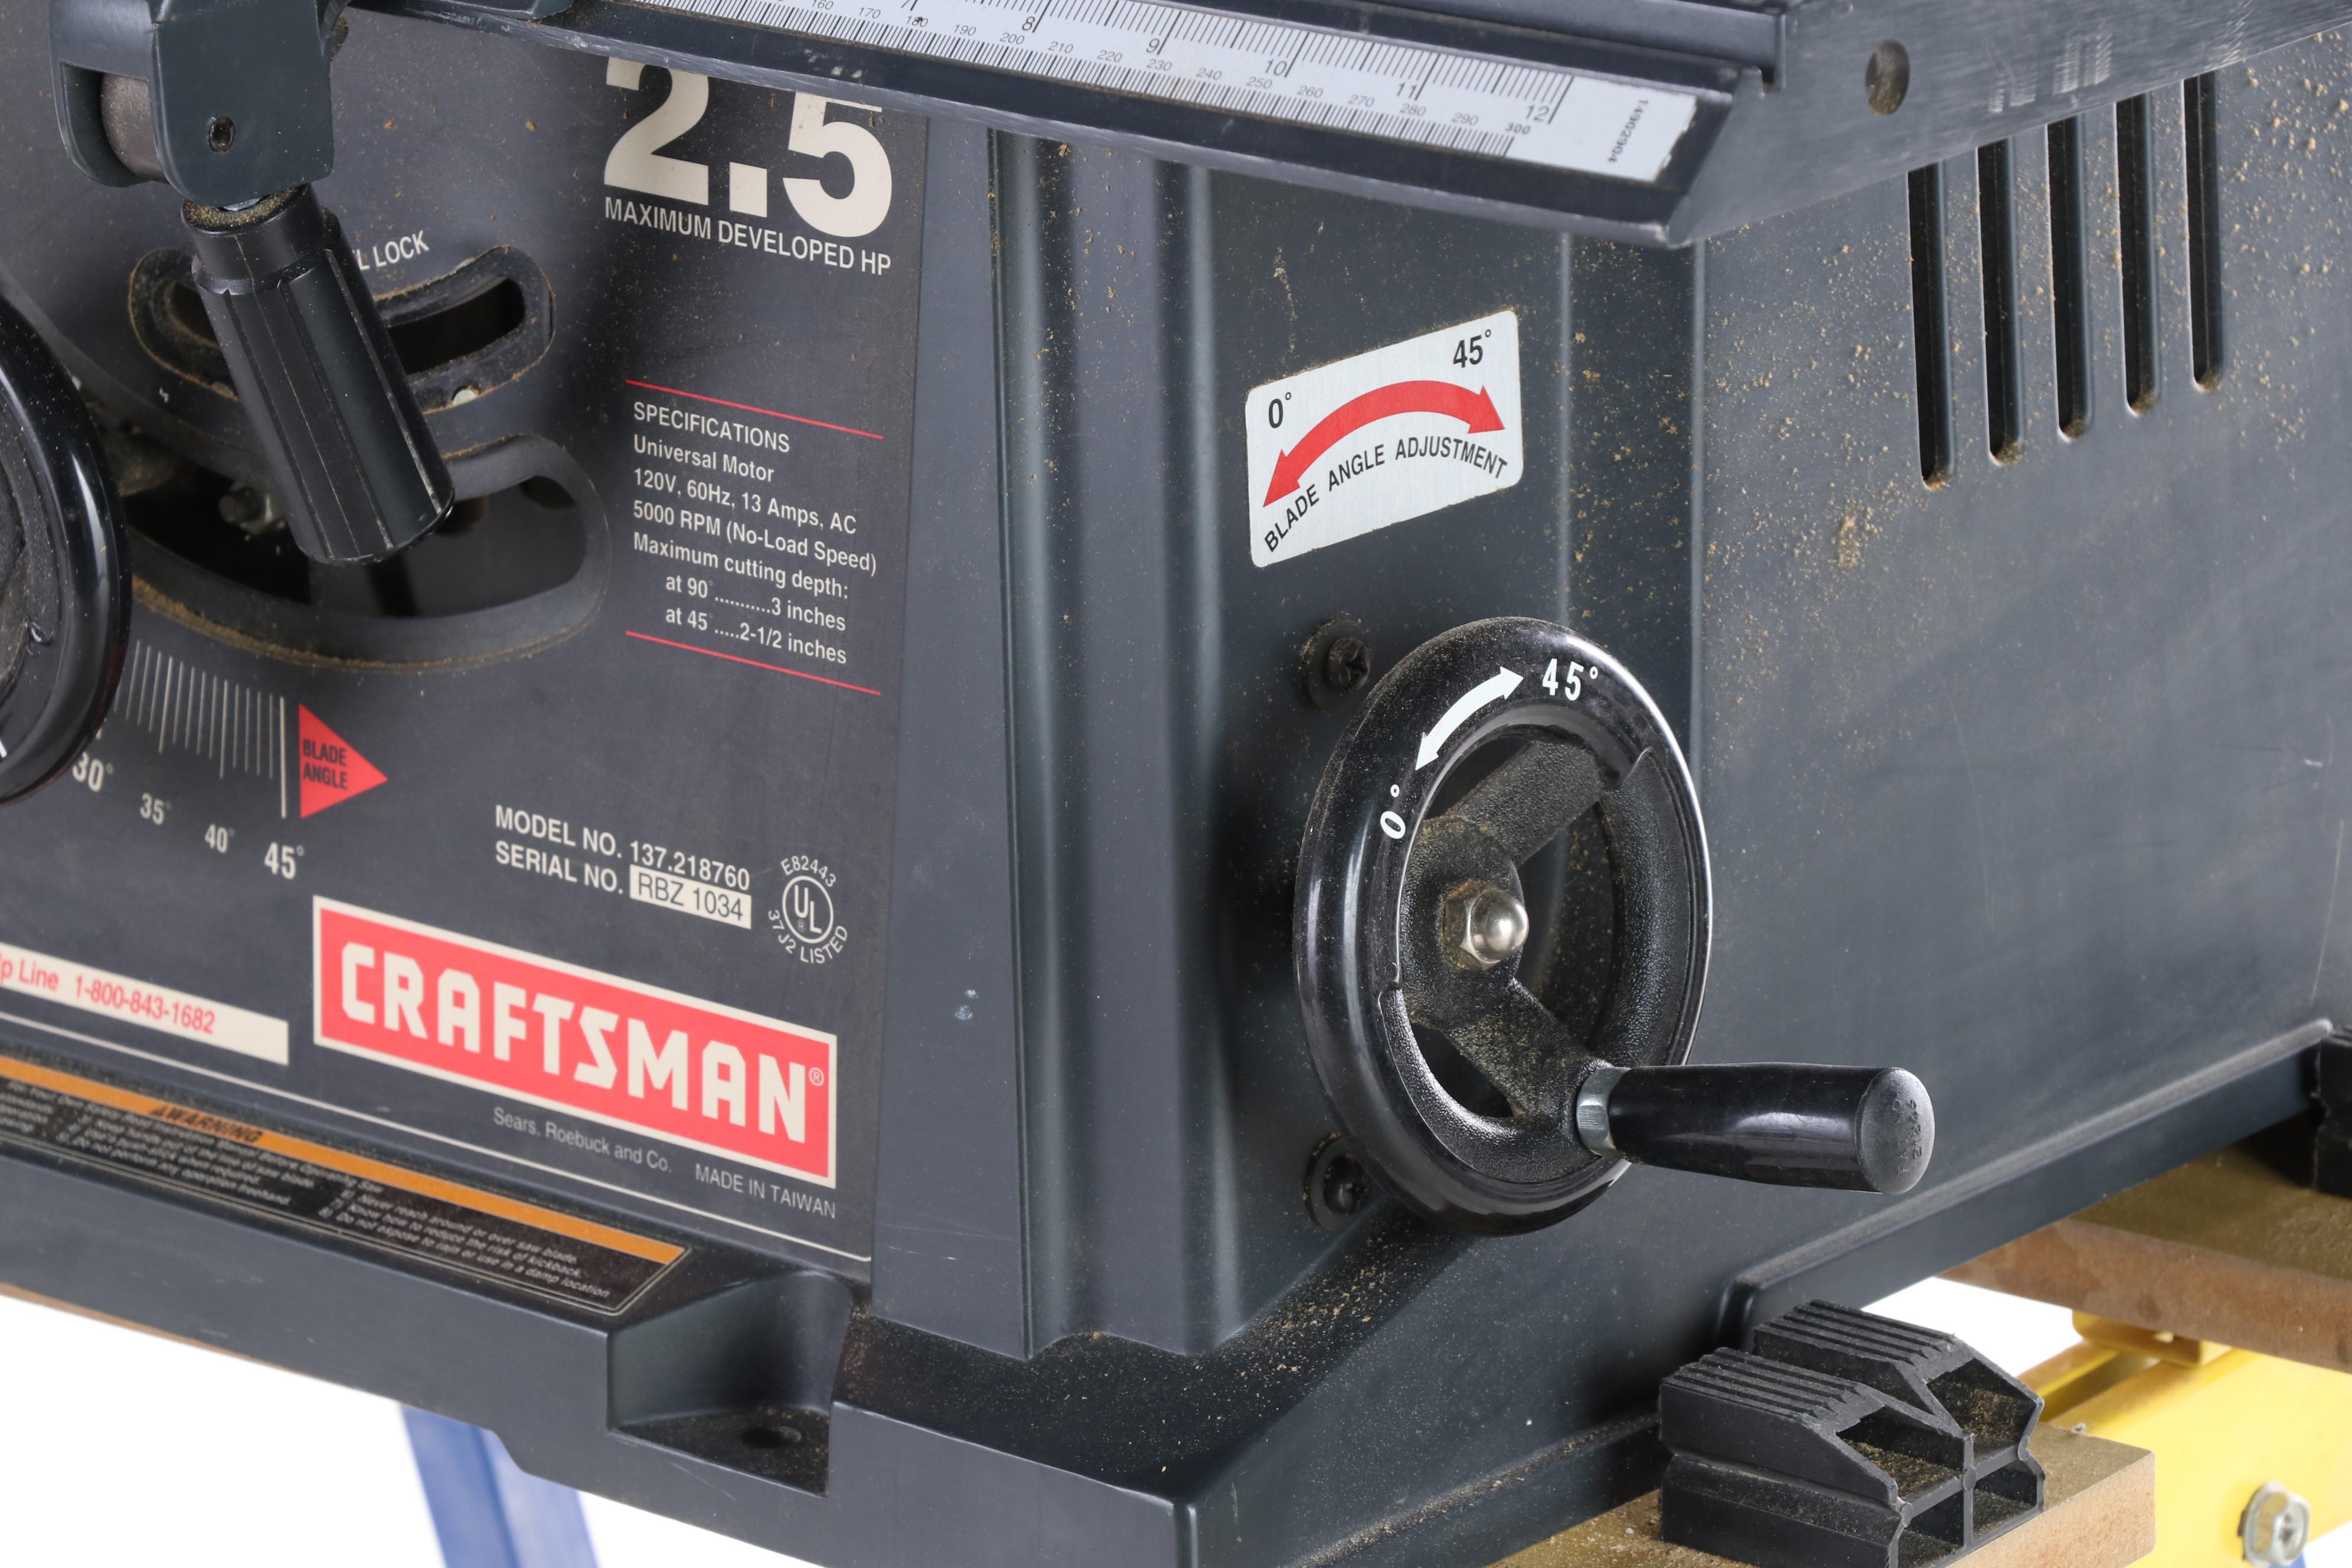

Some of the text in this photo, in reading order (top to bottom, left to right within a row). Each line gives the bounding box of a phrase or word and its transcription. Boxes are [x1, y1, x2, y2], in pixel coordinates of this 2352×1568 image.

[859, 7, 881, 19] 170
[954, 24, 976, 36] 190
[999, 32, 1025, 44] 200
[1048, 41, 1074, 53] 210
[1097, 50, 1123, 62] 220
[1146, 58, 1172, 71] 230
[1195, 67, 1222, 80] 240
[1246, 76, 1273, 89] 250
[1297, 85, 1323, 98] 260
[1348, 94, 1375, 107] 270
[1399, 103, 1426, 116] 280
[1452, 112, 1479, 125] 290
[1505, 122, 1531, 135] 300
[1021, 16, 1550, 122] 8 9 10 11 12
[604, 57, 892, 237] 2.5
[373, 230, 429, 267] LOCK
[605, 197, 891, 275] MAXIMUM DEVELOPED HP
[1453, 329, 1491, 368] 45°
[634, 401, 790, 453] SPECIFICATIONS
[634, 434, 774, 482] Universal Motor
[634, 468, 857, 534] 120V, 60Hz, 13 Amps, AC
[1265, 436, 1508, 553] BLADE ANGLE ADJUSTMENT
[633, 499, 877, 577] 5000 RPM (No-Load Speed)
[634, 531, 848, 599] Maximum cutting depth:
[665, 575, 682, 593] at
[788, 600, 846, 631] inches
[665, 607, 682, 625] at
[788, 633, 847, 664] inches
[1542, 658, 1599, 701] 45°
[302, 739, 347, 767] BLADE
[302, 762, 348, 790] ANGLE
[495, 804, 750, 891] MODEL NO. 137.218760
[780, 855, 836, 887] E82443
[496, 840, 743, 922] SERIAL NO. RBZ 1034
[800, 925, 848, 964] LISTED
[19, 958, 59, 991] Line
[76, 975, 215, 1034] 1-800-843-1682
[166, 1107, 263, 1143] WARNING
[545, 1121, 610, 1155] Roebuck
[614, 1144, 642, 1164] and
[646, 1150, 672, 1173] Co.
[695, 1164, 836, 1219] MADE IN TAIWAN
[525, 1268, 560, 1285] damp
[560, 1277, 610, 1298] location
